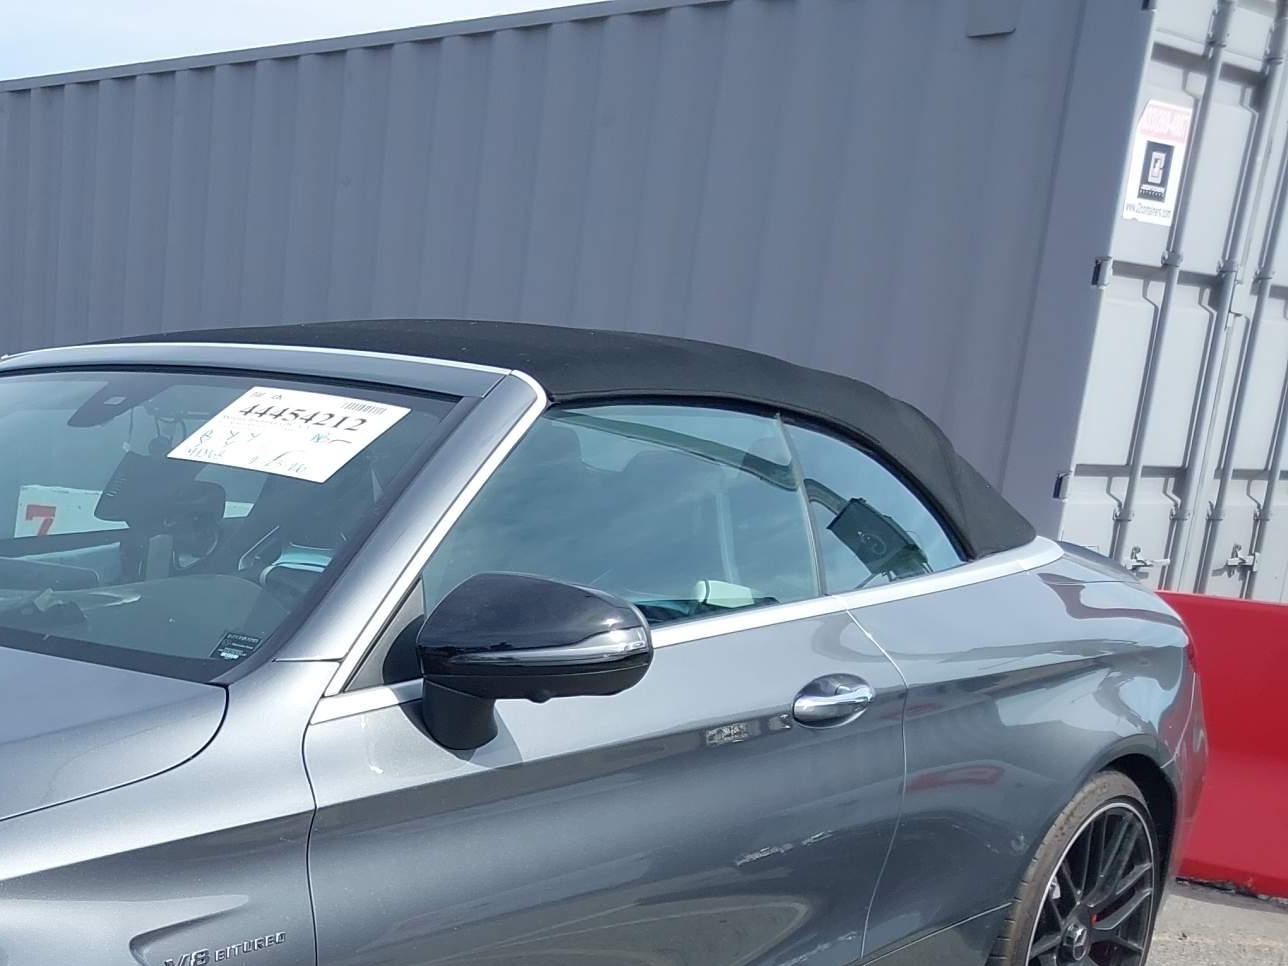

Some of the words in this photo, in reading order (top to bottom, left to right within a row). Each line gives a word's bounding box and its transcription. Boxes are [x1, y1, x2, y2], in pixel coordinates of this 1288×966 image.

[239, 403, 368, 431] 44454212
[25, 504, 56, 536] 7
[215, 932, 285, 962] BITURBO
